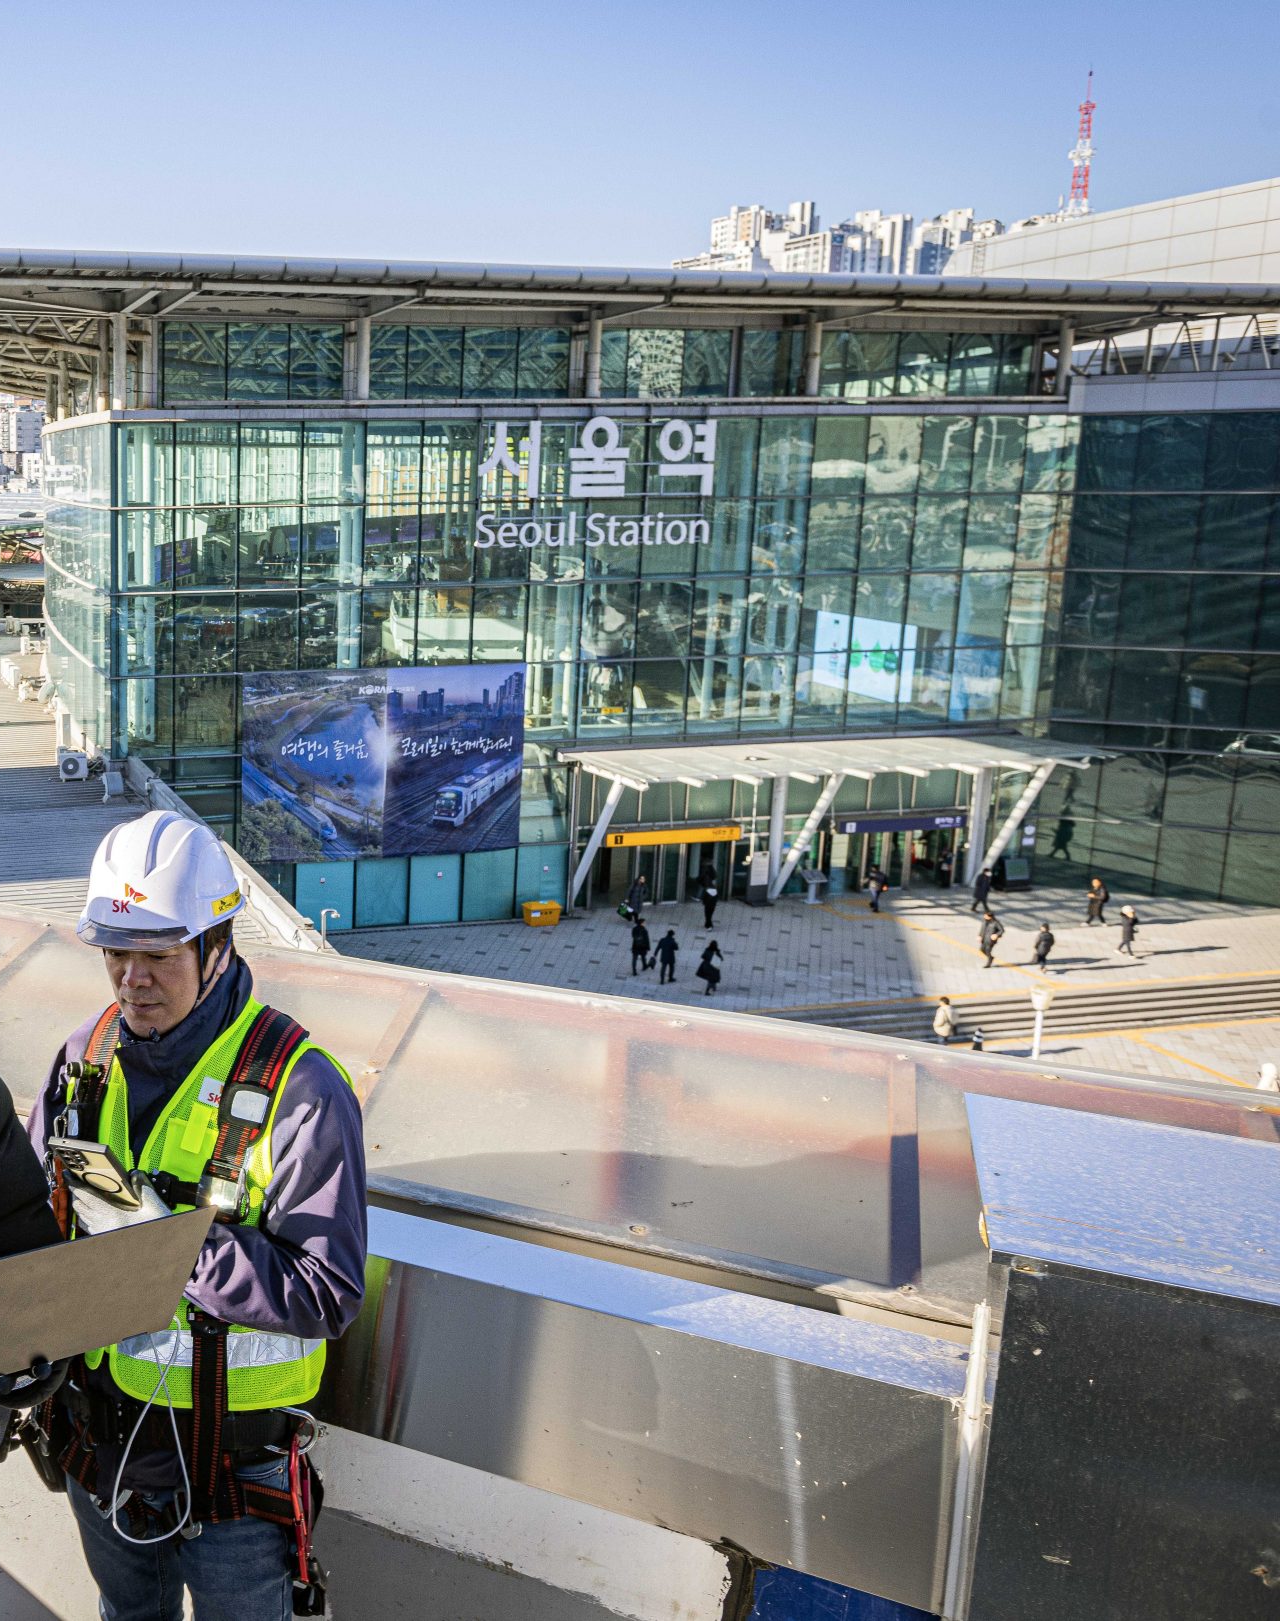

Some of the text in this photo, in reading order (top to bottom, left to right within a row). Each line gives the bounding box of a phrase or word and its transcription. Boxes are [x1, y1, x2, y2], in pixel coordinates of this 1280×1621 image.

[478, 416, 718, 498] 서울역
[475, 511, 711, 549] Seoul Station
[281, 738, 328, 761] 여행의
[401, 736, 447, 757] 코레일이
[111, 899, 131, 914] SK
